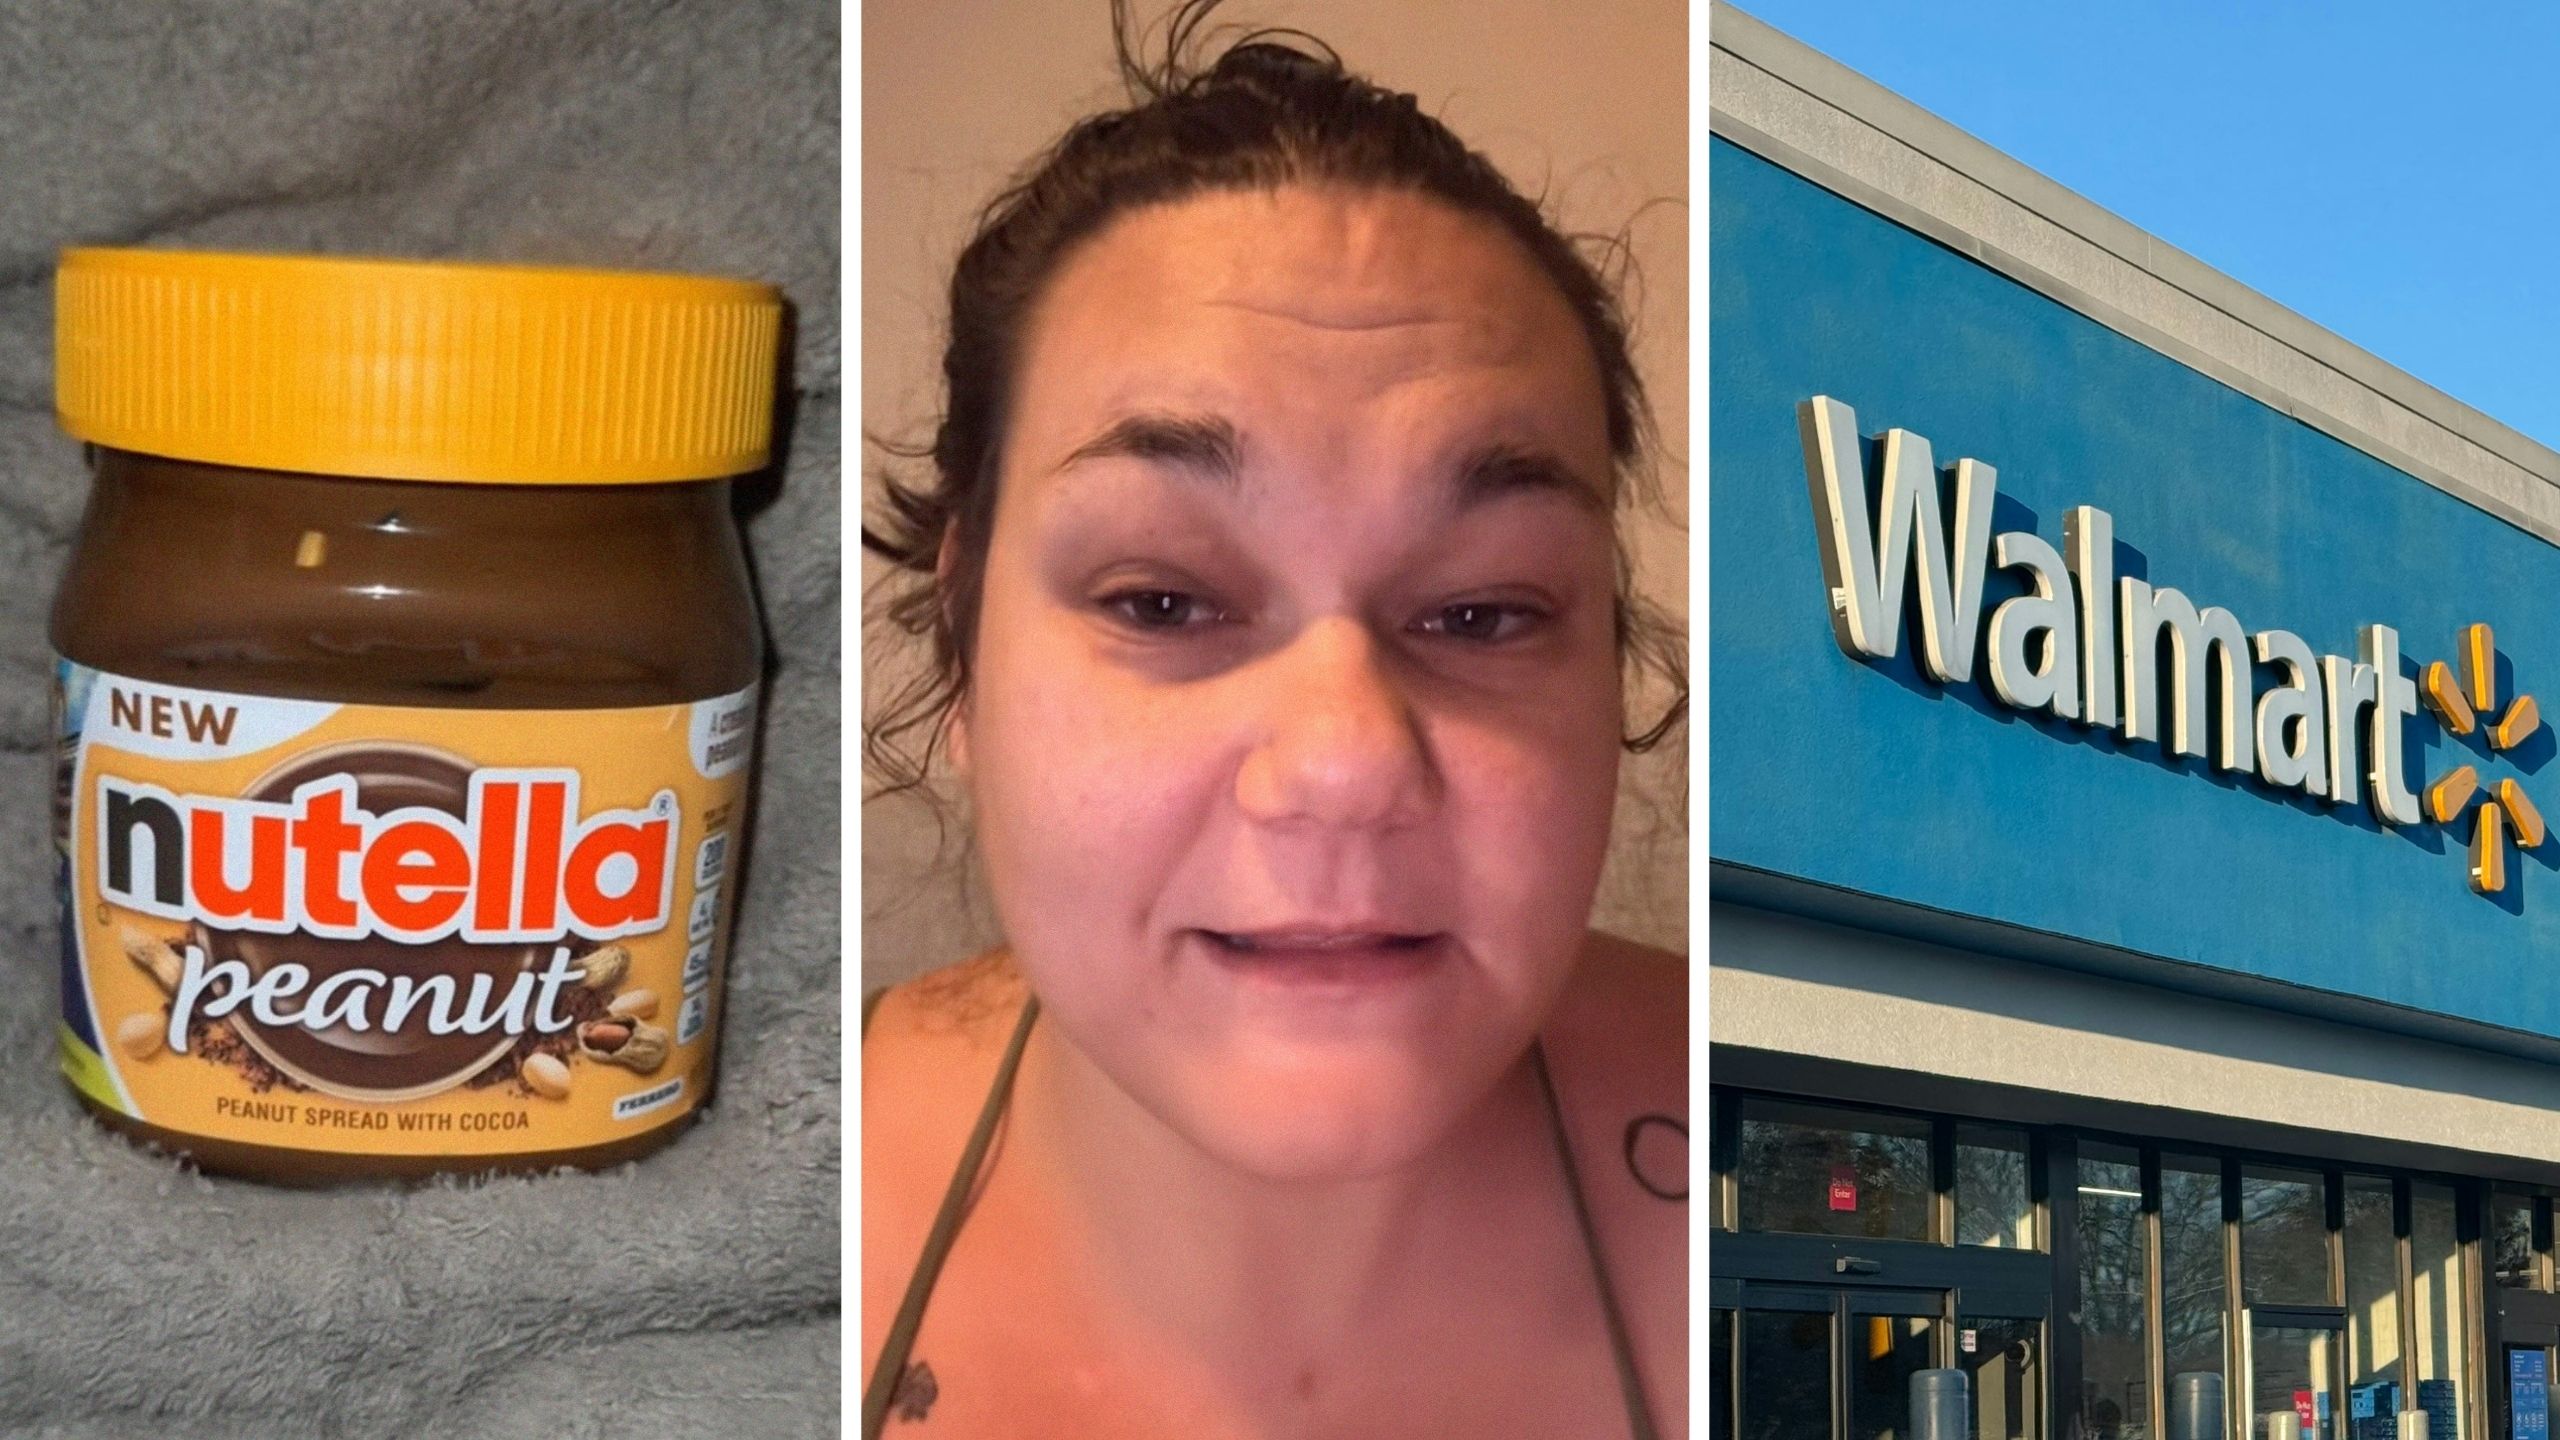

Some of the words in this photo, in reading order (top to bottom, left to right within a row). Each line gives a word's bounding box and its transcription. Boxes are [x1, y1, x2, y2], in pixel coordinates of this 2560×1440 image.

[1800, 395, 2421, 826] Walmart
[111, 687, 238, 747] NEW
[105, 781, 670, 932] nutella
[168, 946, 587, 1056] peanut
[216, 1096, 299, 1124] PEANUT
[305, 1103, 389, 1130] SPREAD
[397, 1109, 451, 1131] WITH
[458, 1110, 530, 1132] COCOA
[1834, 1188, 1851, 1199] Enter
